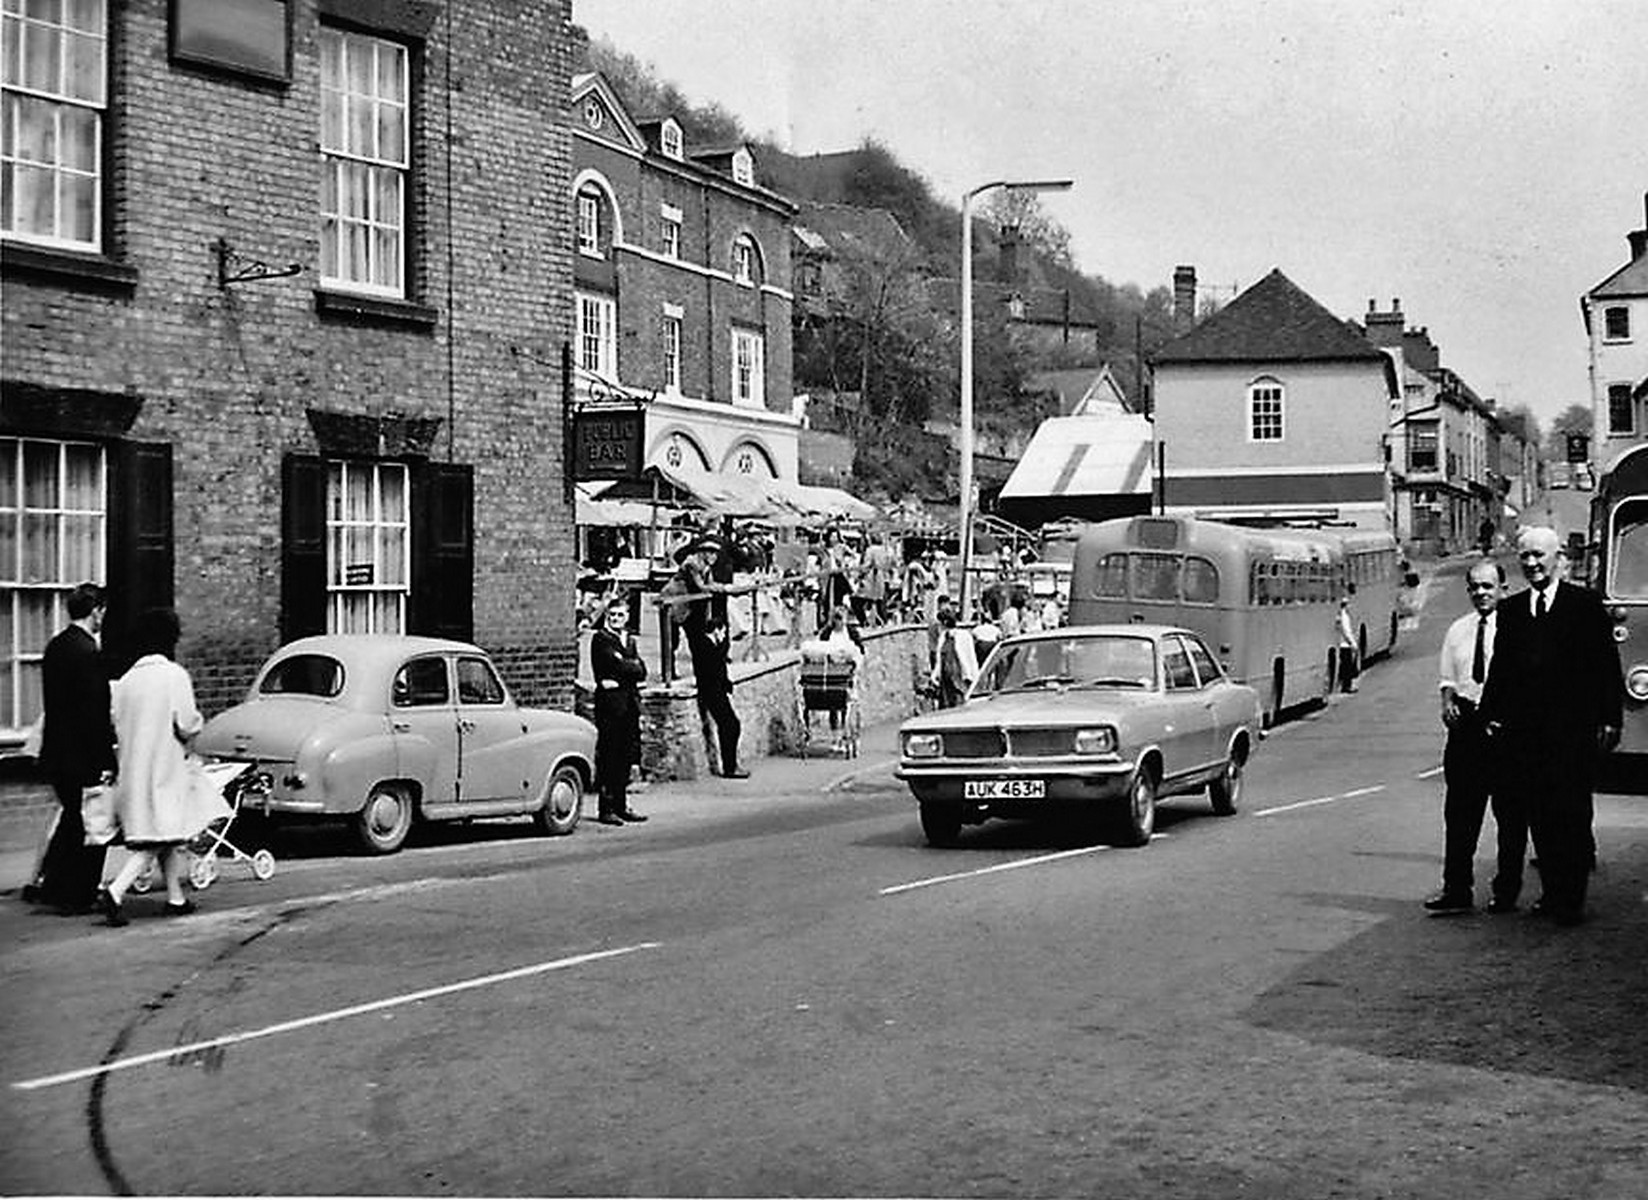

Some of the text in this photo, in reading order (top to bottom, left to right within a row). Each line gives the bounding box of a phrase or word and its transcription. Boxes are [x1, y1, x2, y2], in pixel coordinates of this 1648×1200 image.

[583, 420, 635, 442] PUBLIC
[588, 442, 627, 461] BAR
[968, 782, 1042, 796] AUK 463H
